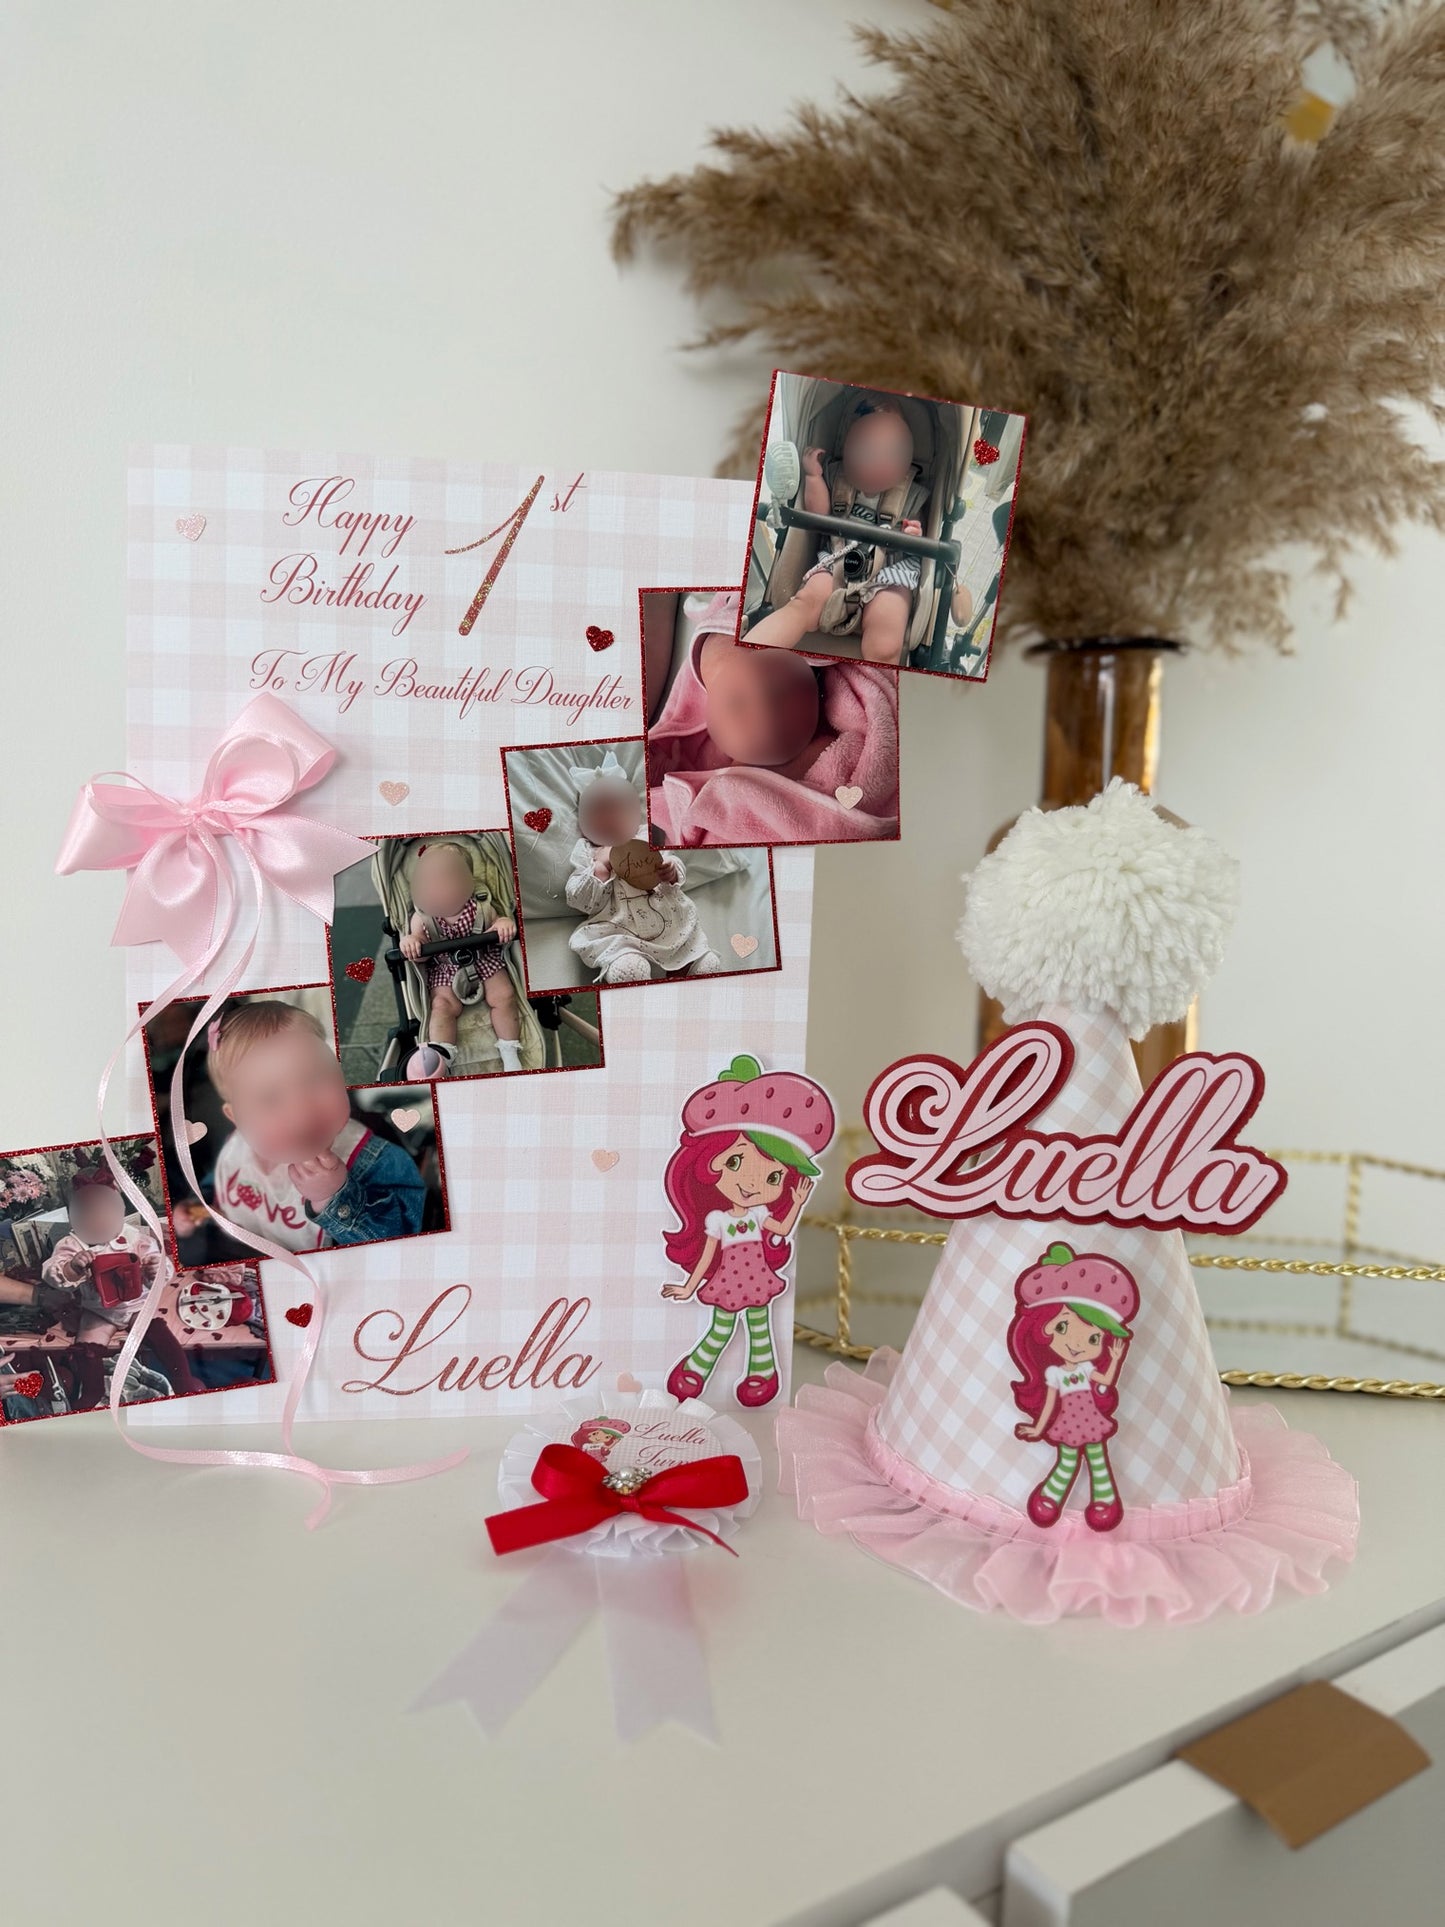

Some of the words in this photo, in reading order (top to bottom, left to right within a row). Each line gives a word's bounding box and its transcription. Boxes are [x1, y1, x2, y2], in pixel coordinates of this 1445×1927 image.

[259, 552, 427, 637] Birthday
[281, 475, 417, 558] Happy
[444, 472, 588, 636] 1st
[249, 648, 302, 692] To
[294, 649, 367, 715] My
[373, 656, 514, 719] Beautiful
[510, 665, 635, 727] Daughter
[861, 1037, 1268, 1214] Luella
[341, 1283, 603, 1396] Luella
[631, 1420, 706, 1445] Luella
